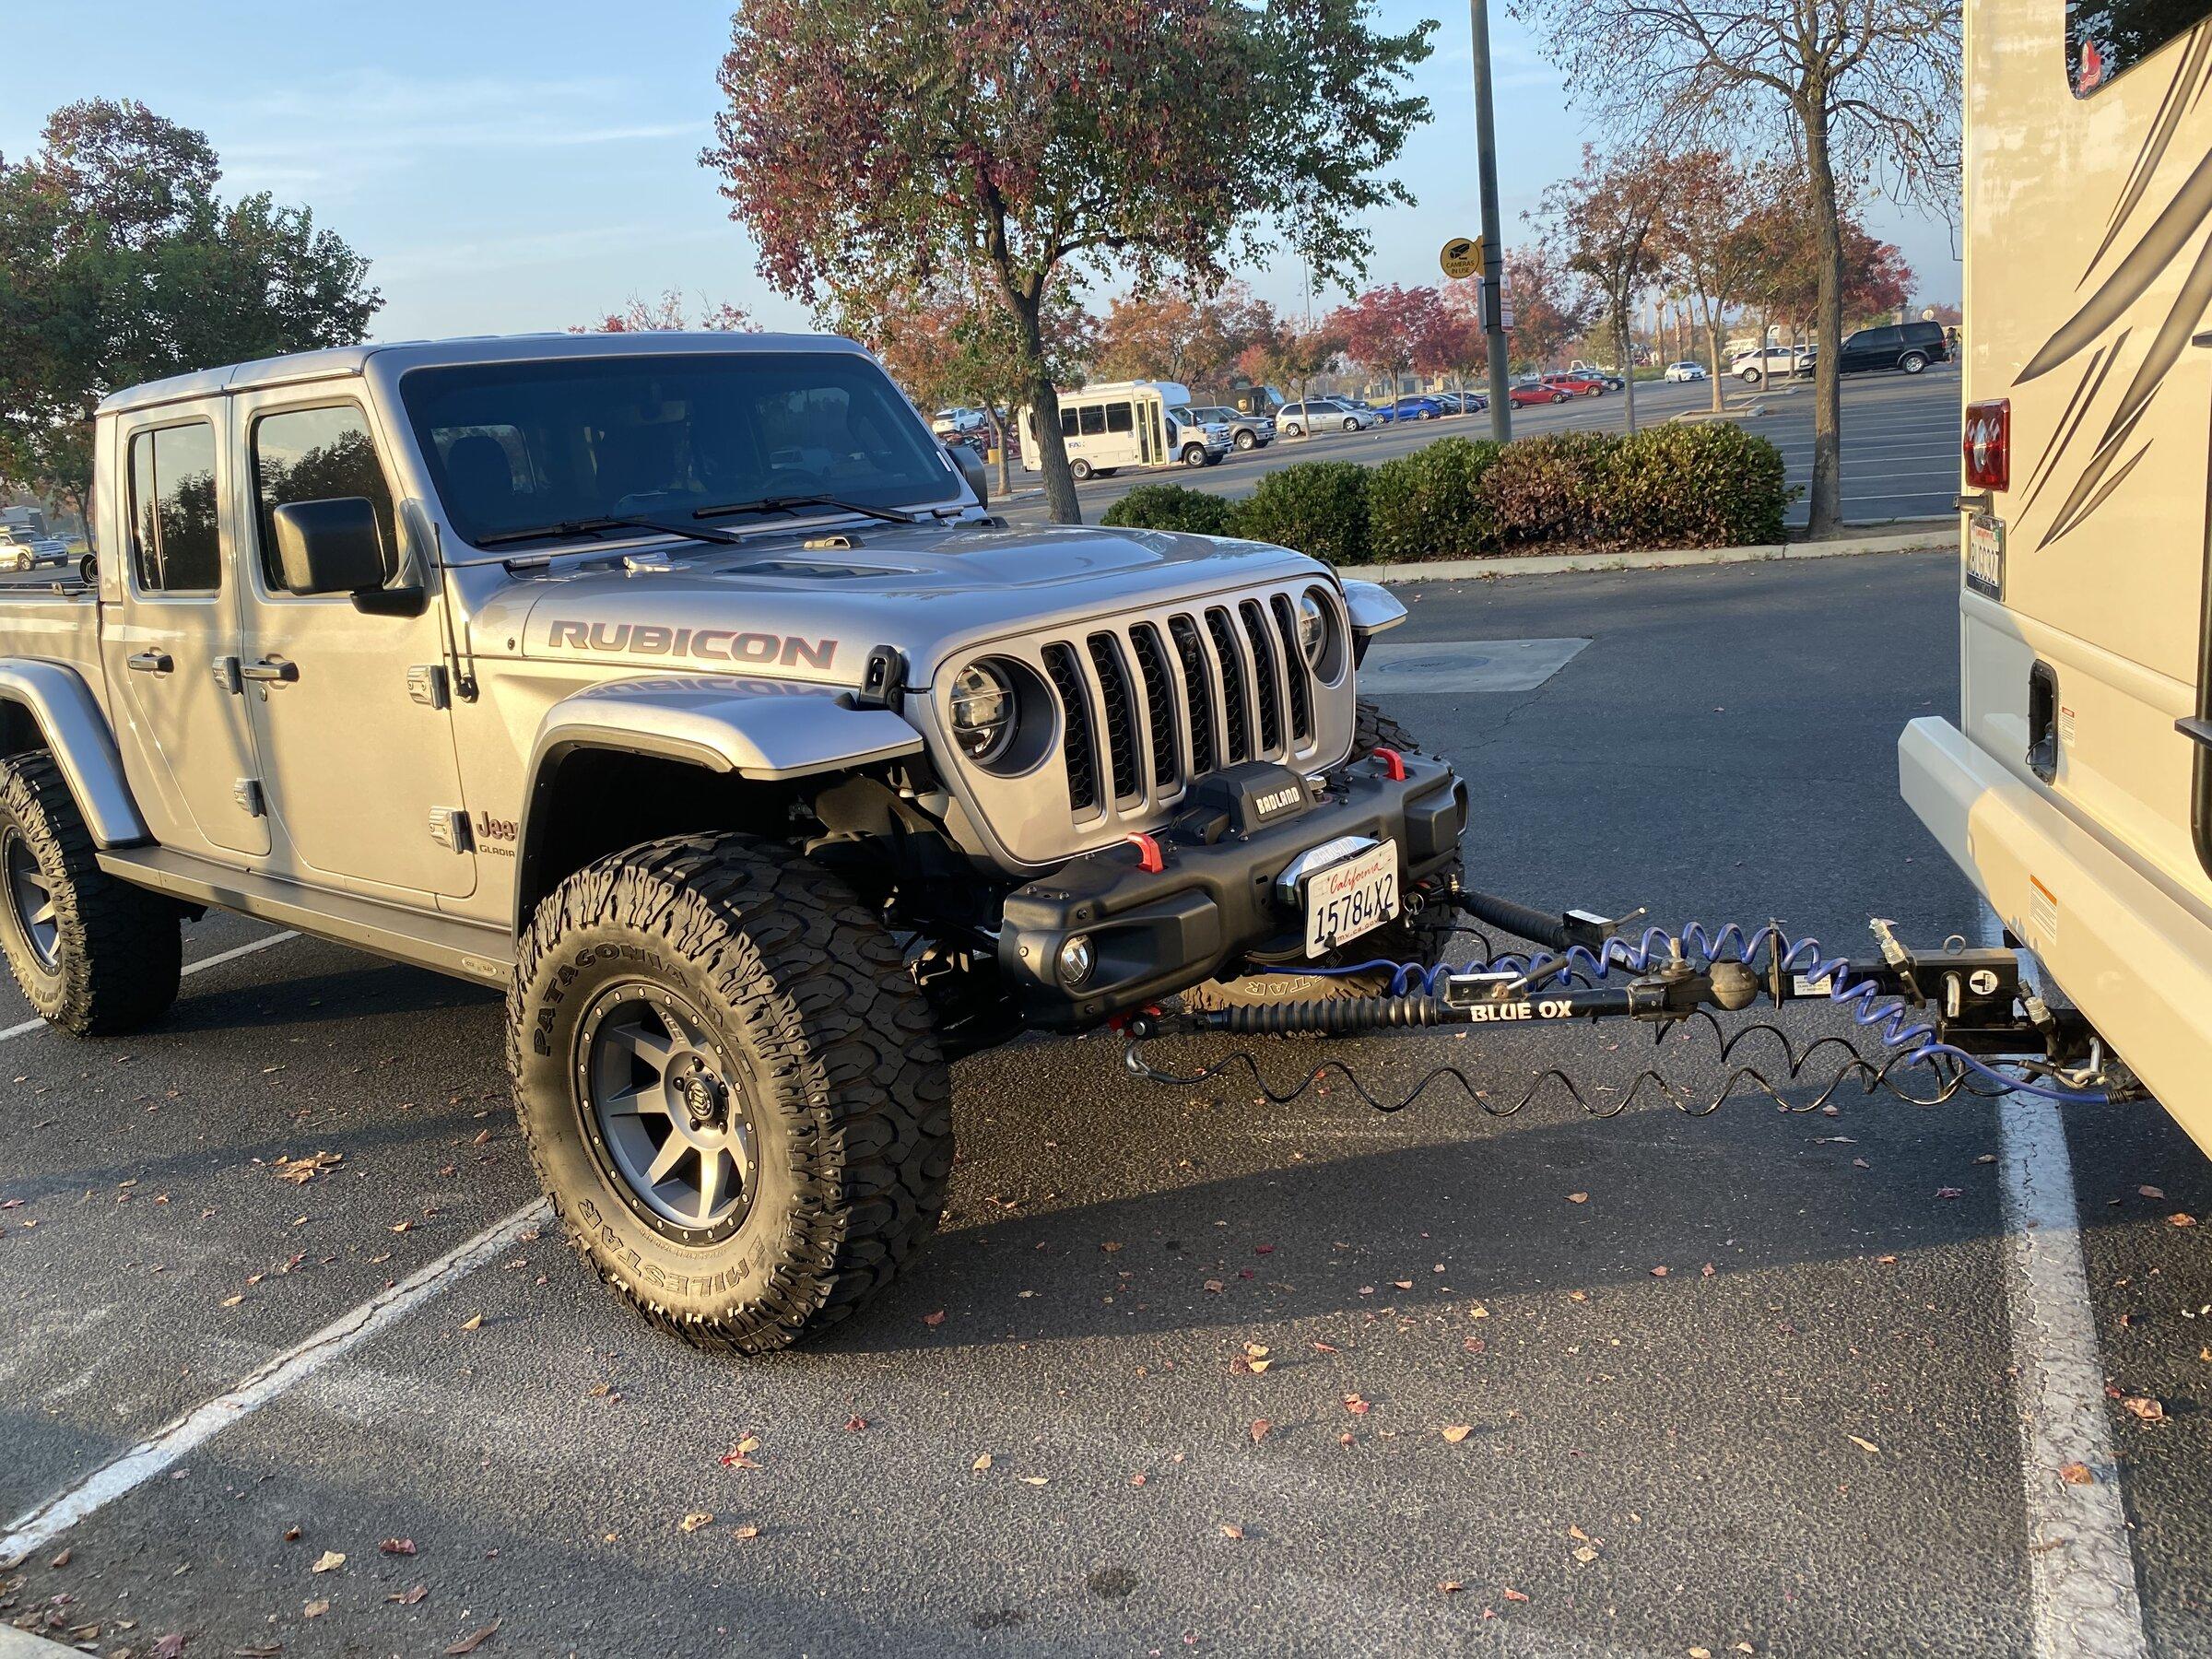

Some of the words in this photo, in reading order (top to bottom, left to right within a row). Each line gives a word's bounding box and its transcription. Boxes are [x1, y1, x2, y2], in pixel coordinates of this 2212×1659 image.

[1446, 260, 1475, 268] CAMERAS
[548, 620, 838, 669] RUBICON
[1255, 786, 1300, 815] BADLAND
[479, 845, 515, 857] GLADIA
[1329, 862, 1384, 894] California
[1313, 874, 1394, 944] 15784X2
[1336, 917, 1380, 941] mv.ca.gov
[534, 942, 688, 1056] PATAGONIA
[1470, 1002, 1532, 1022] BLUE
[1539, 1000, 1572, 1018] OX
[578, 1199, 750, 1297] MILESTAR
